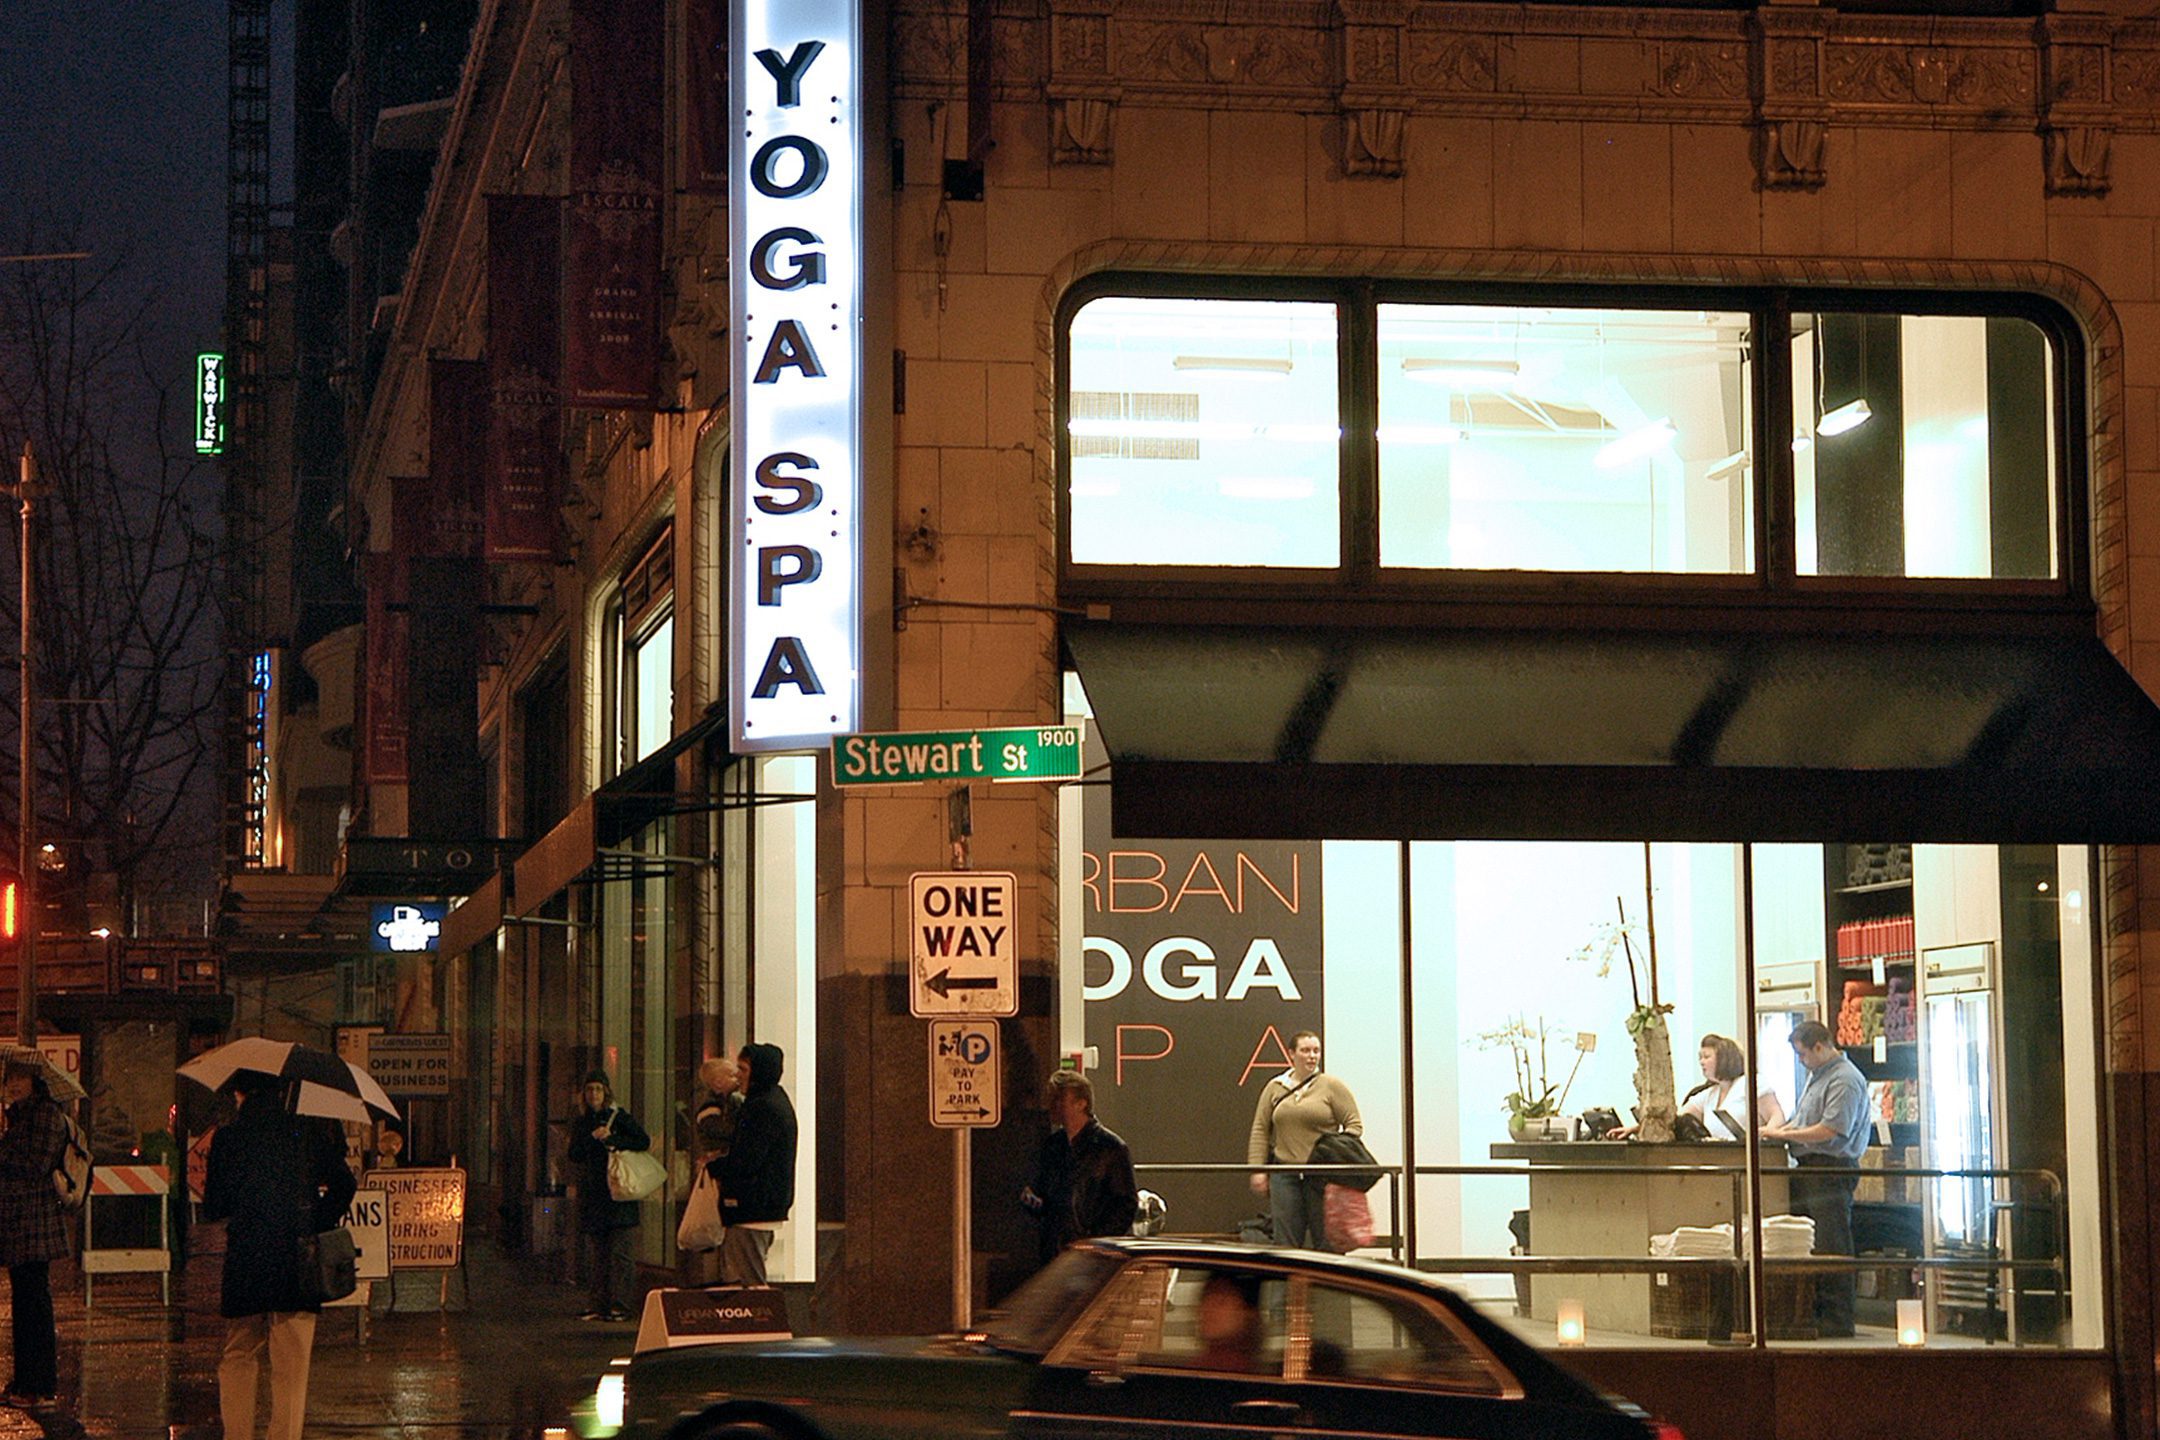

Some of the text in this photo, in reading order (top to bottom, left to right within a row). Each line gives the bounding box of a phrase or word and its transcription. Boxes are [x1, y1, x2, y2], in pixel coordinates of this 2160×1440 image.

[582, 195, 655, 209] ESCALA
[750, 40, 828, 698] YOGA SPA
[203, 357, 218, 439] WARWICK
[844, 730, 1075, 776] Stewart St 1900
[923, 886, 1003, 917] ONE
[923, 926, 1006, 957] WAY
[370, 1059, 447, 1069] OPEN FOR
[953, 1068, 975, 1078] PAY
[957, 1082, 972, 1092] TO
[949, 1095, 981, 1105] PARK
